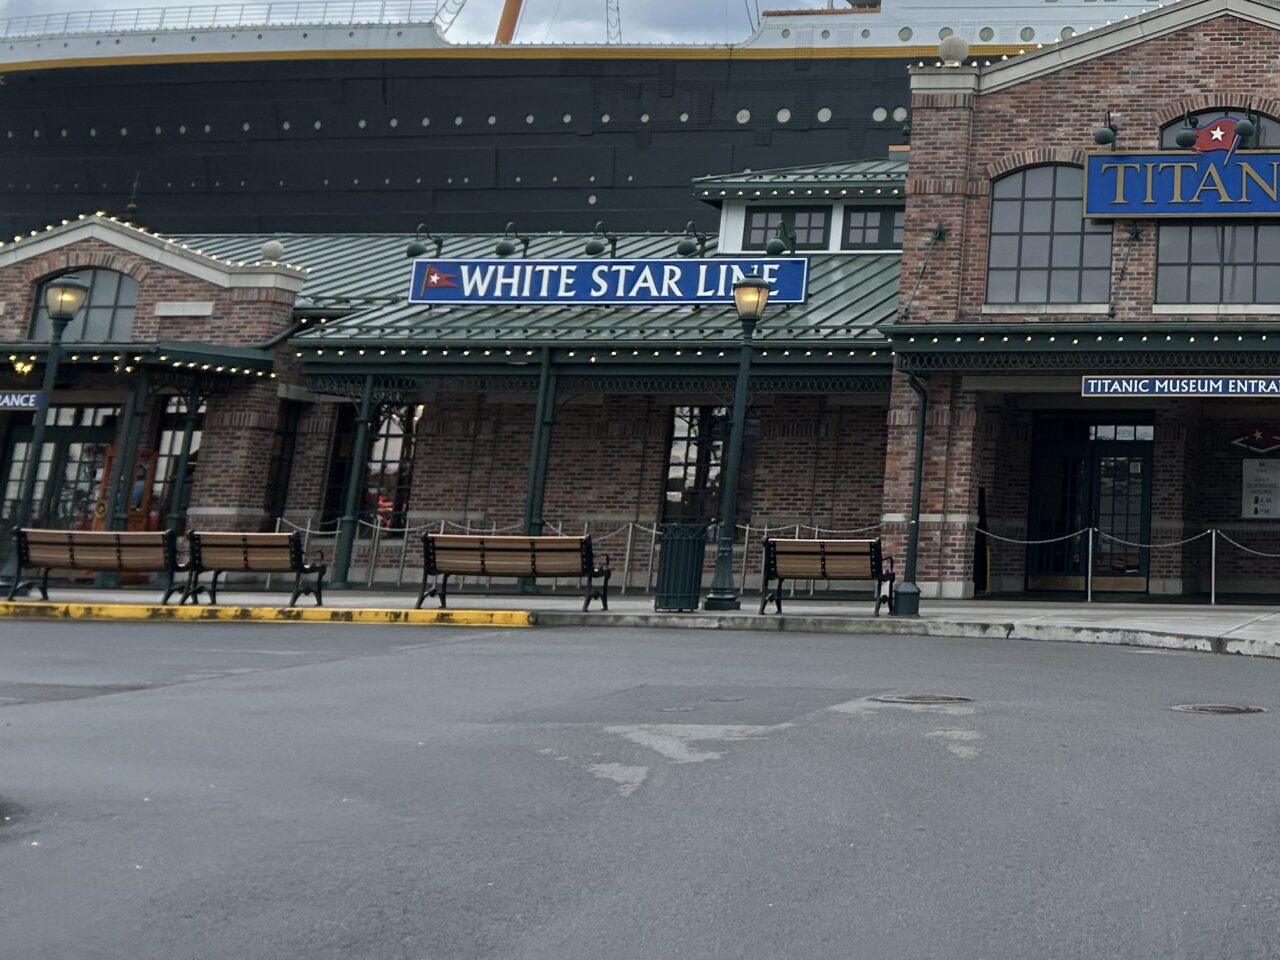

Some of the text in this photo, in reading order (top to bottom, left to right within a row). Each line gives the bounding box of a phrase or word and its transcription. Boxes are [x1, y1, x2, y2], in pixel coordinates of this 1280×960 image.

[460, 264, 578, 297] WHITE
[590, 264, 684, 297] STAR
[1087, 379, 1150, 393] TITANIC
[1154, 379, 1223, 393] MUSEUM
[0, 394, 37, 407] ANCE
